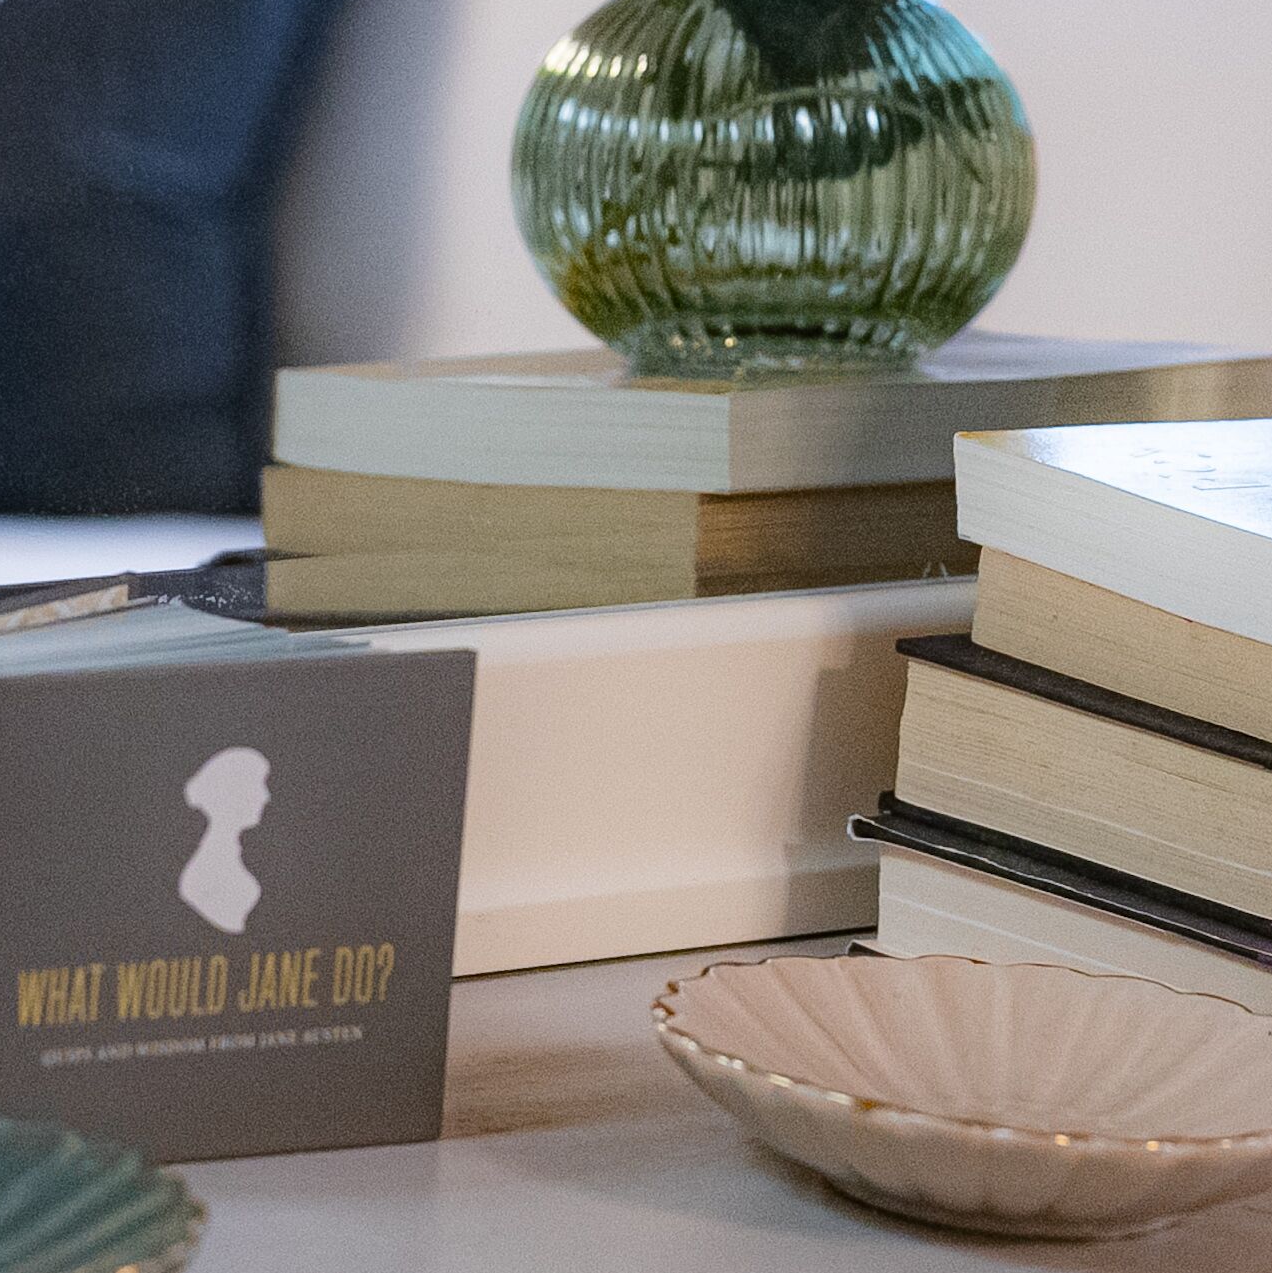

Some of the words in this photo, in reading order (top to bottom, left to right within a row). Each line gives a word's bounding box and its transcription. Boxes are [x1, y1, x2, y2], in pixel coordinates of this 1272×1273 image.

[17, 962, 107, 1026] WHAT
[117, 954, 227, 1021] WOULD
[237, 947, 323, 1013] JANE
[332, 941, 396, 1007] DO?
